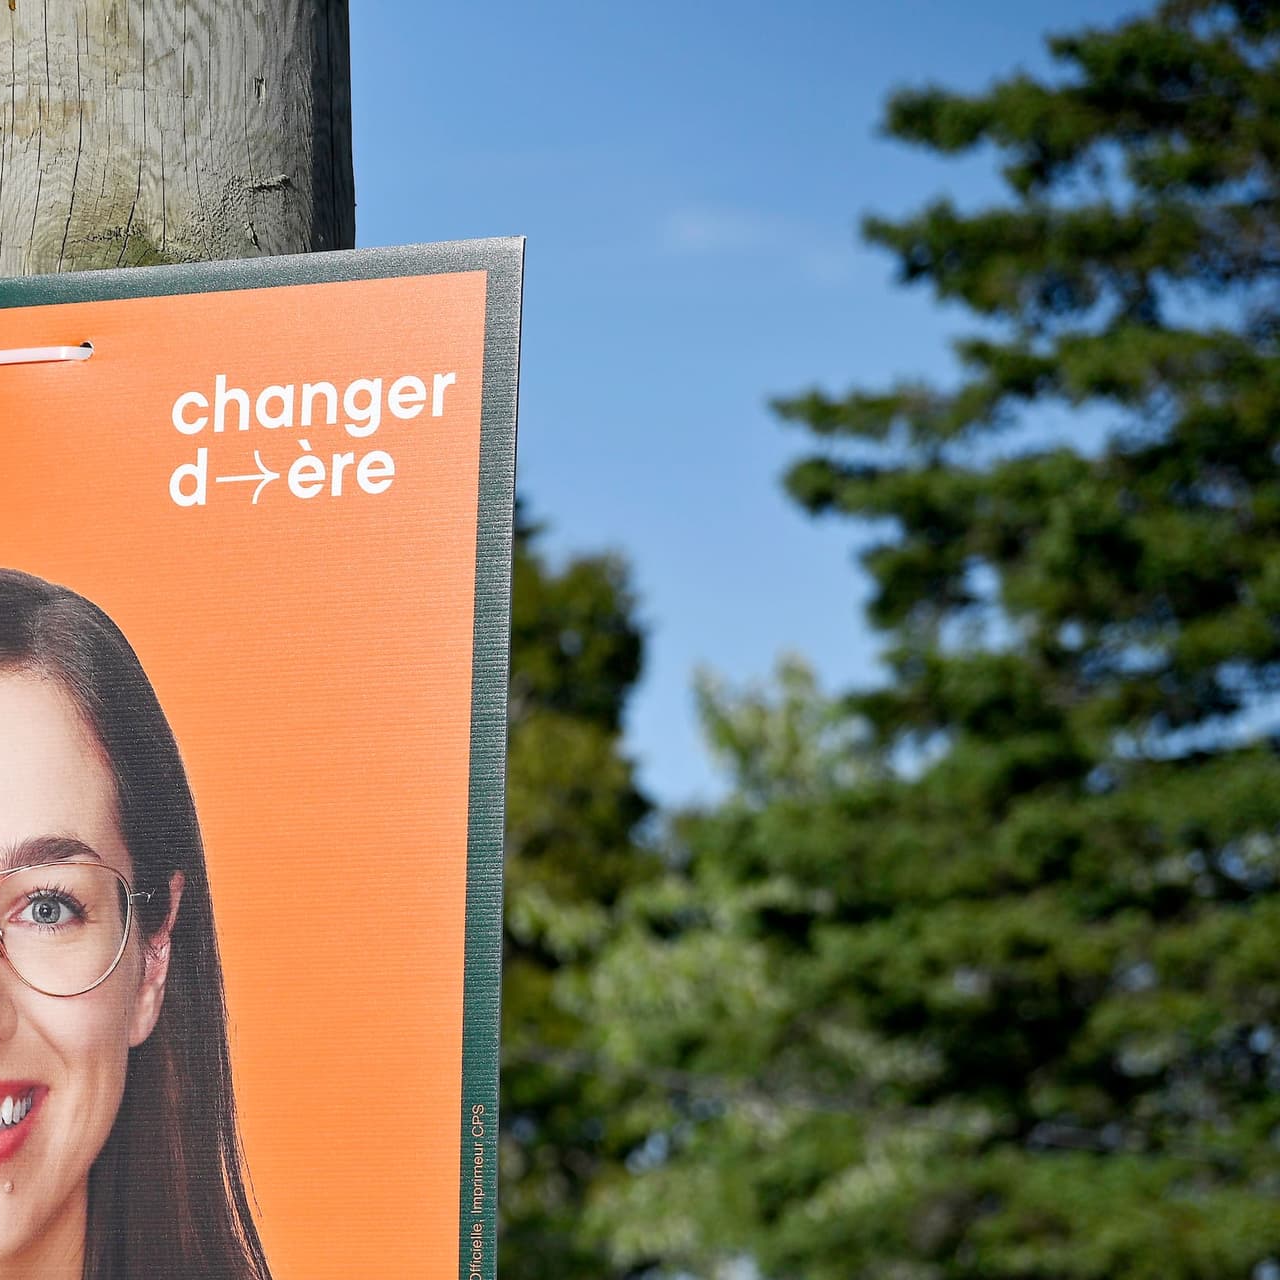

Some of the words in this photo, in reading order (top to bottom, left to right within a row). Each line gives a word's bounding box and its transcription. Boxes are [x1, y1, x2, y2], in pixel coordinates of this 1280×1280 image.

[171, 370, 459, 439] changer
[472, 1103, 485, 1137] CPS
[470, 1141, 485, 1214] Imprimeur
